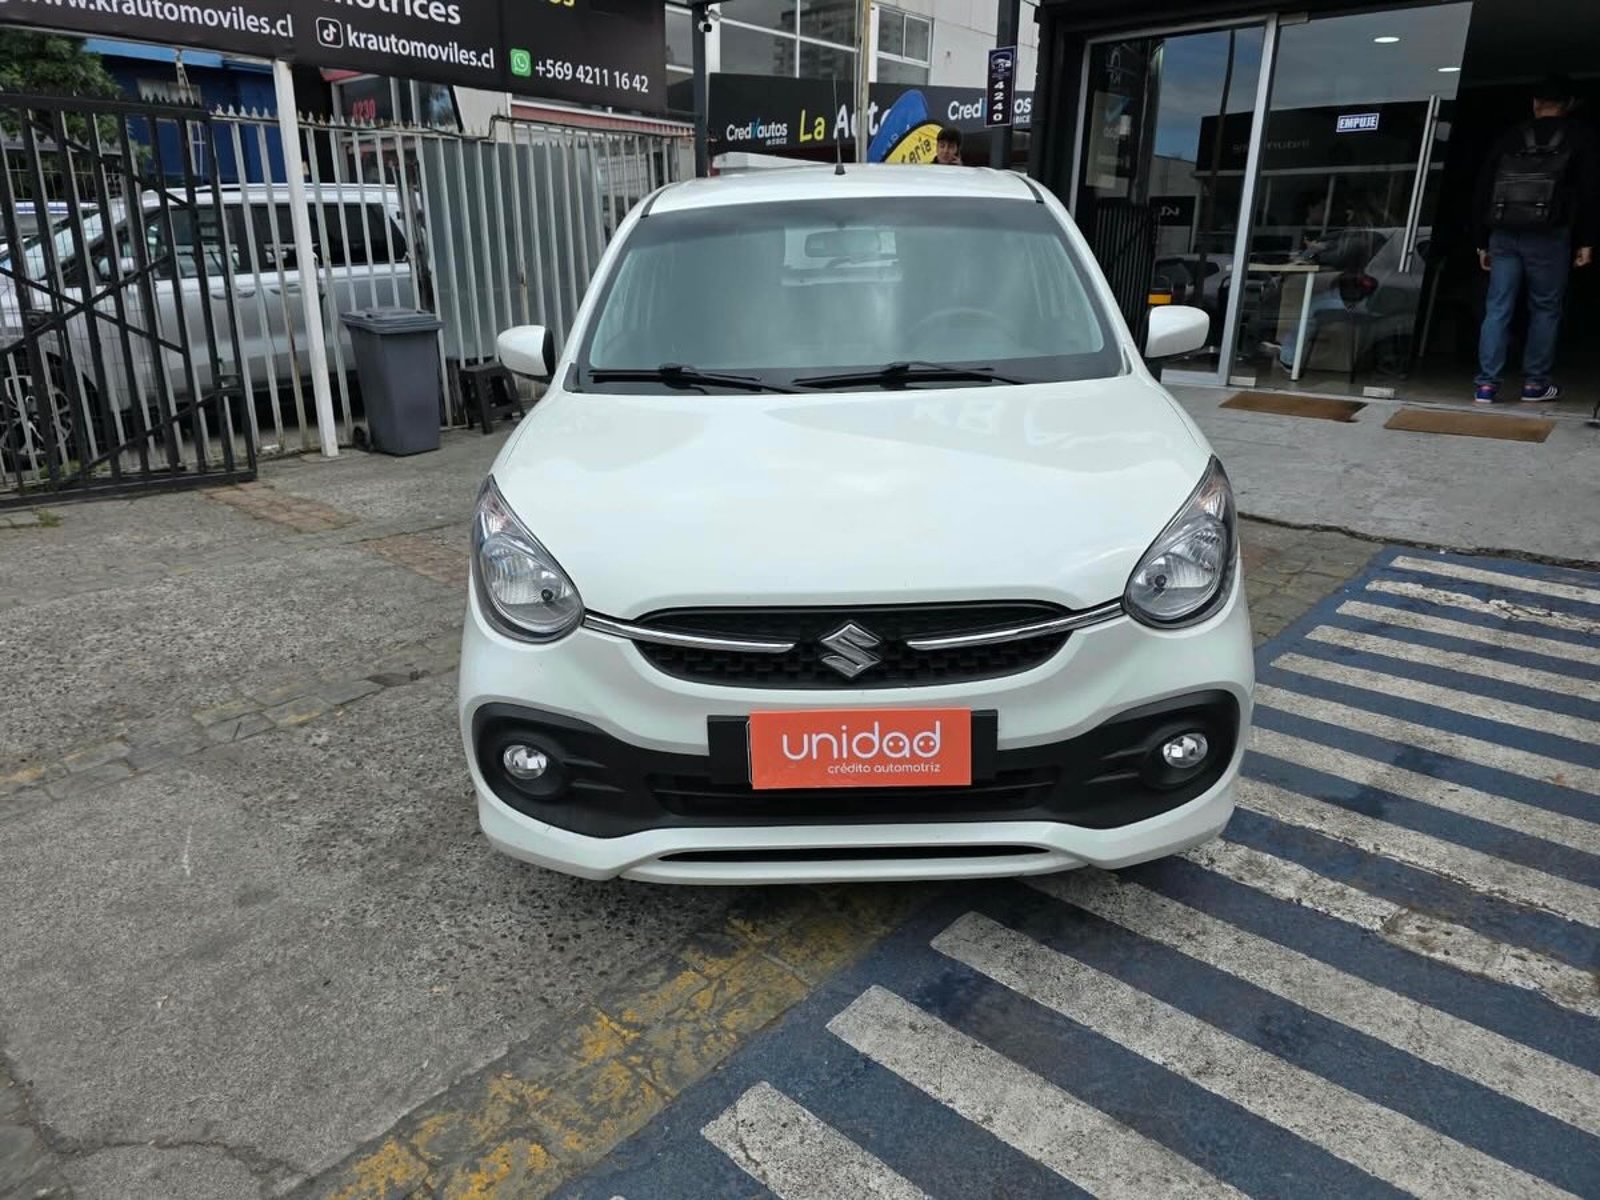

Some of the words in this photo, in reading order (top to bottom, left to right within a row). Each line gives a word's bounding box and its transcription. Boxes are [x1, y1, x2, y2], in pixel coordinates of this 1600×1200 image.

[21, 0, 294, 38] .krautomoviles.cl
[347, 24, 495, 69] krautomoviles.cl
[536, 59, 573, 81] +569
[576, 65, 609, 87] 4211
[613, 71, 630, 90] 16
[632, 74, 649, 93] 42
[993, 81, 1004, 121] 4240
[800, 109, 826, 142] La
[833, 101, 892, 139] At
[1339, 116, 1377, 129] EMPUJE
[782, 720, 941, 761] unidad
[827, 762, 871, 775] crédito
[873, 762, 941, 774] automotriz
